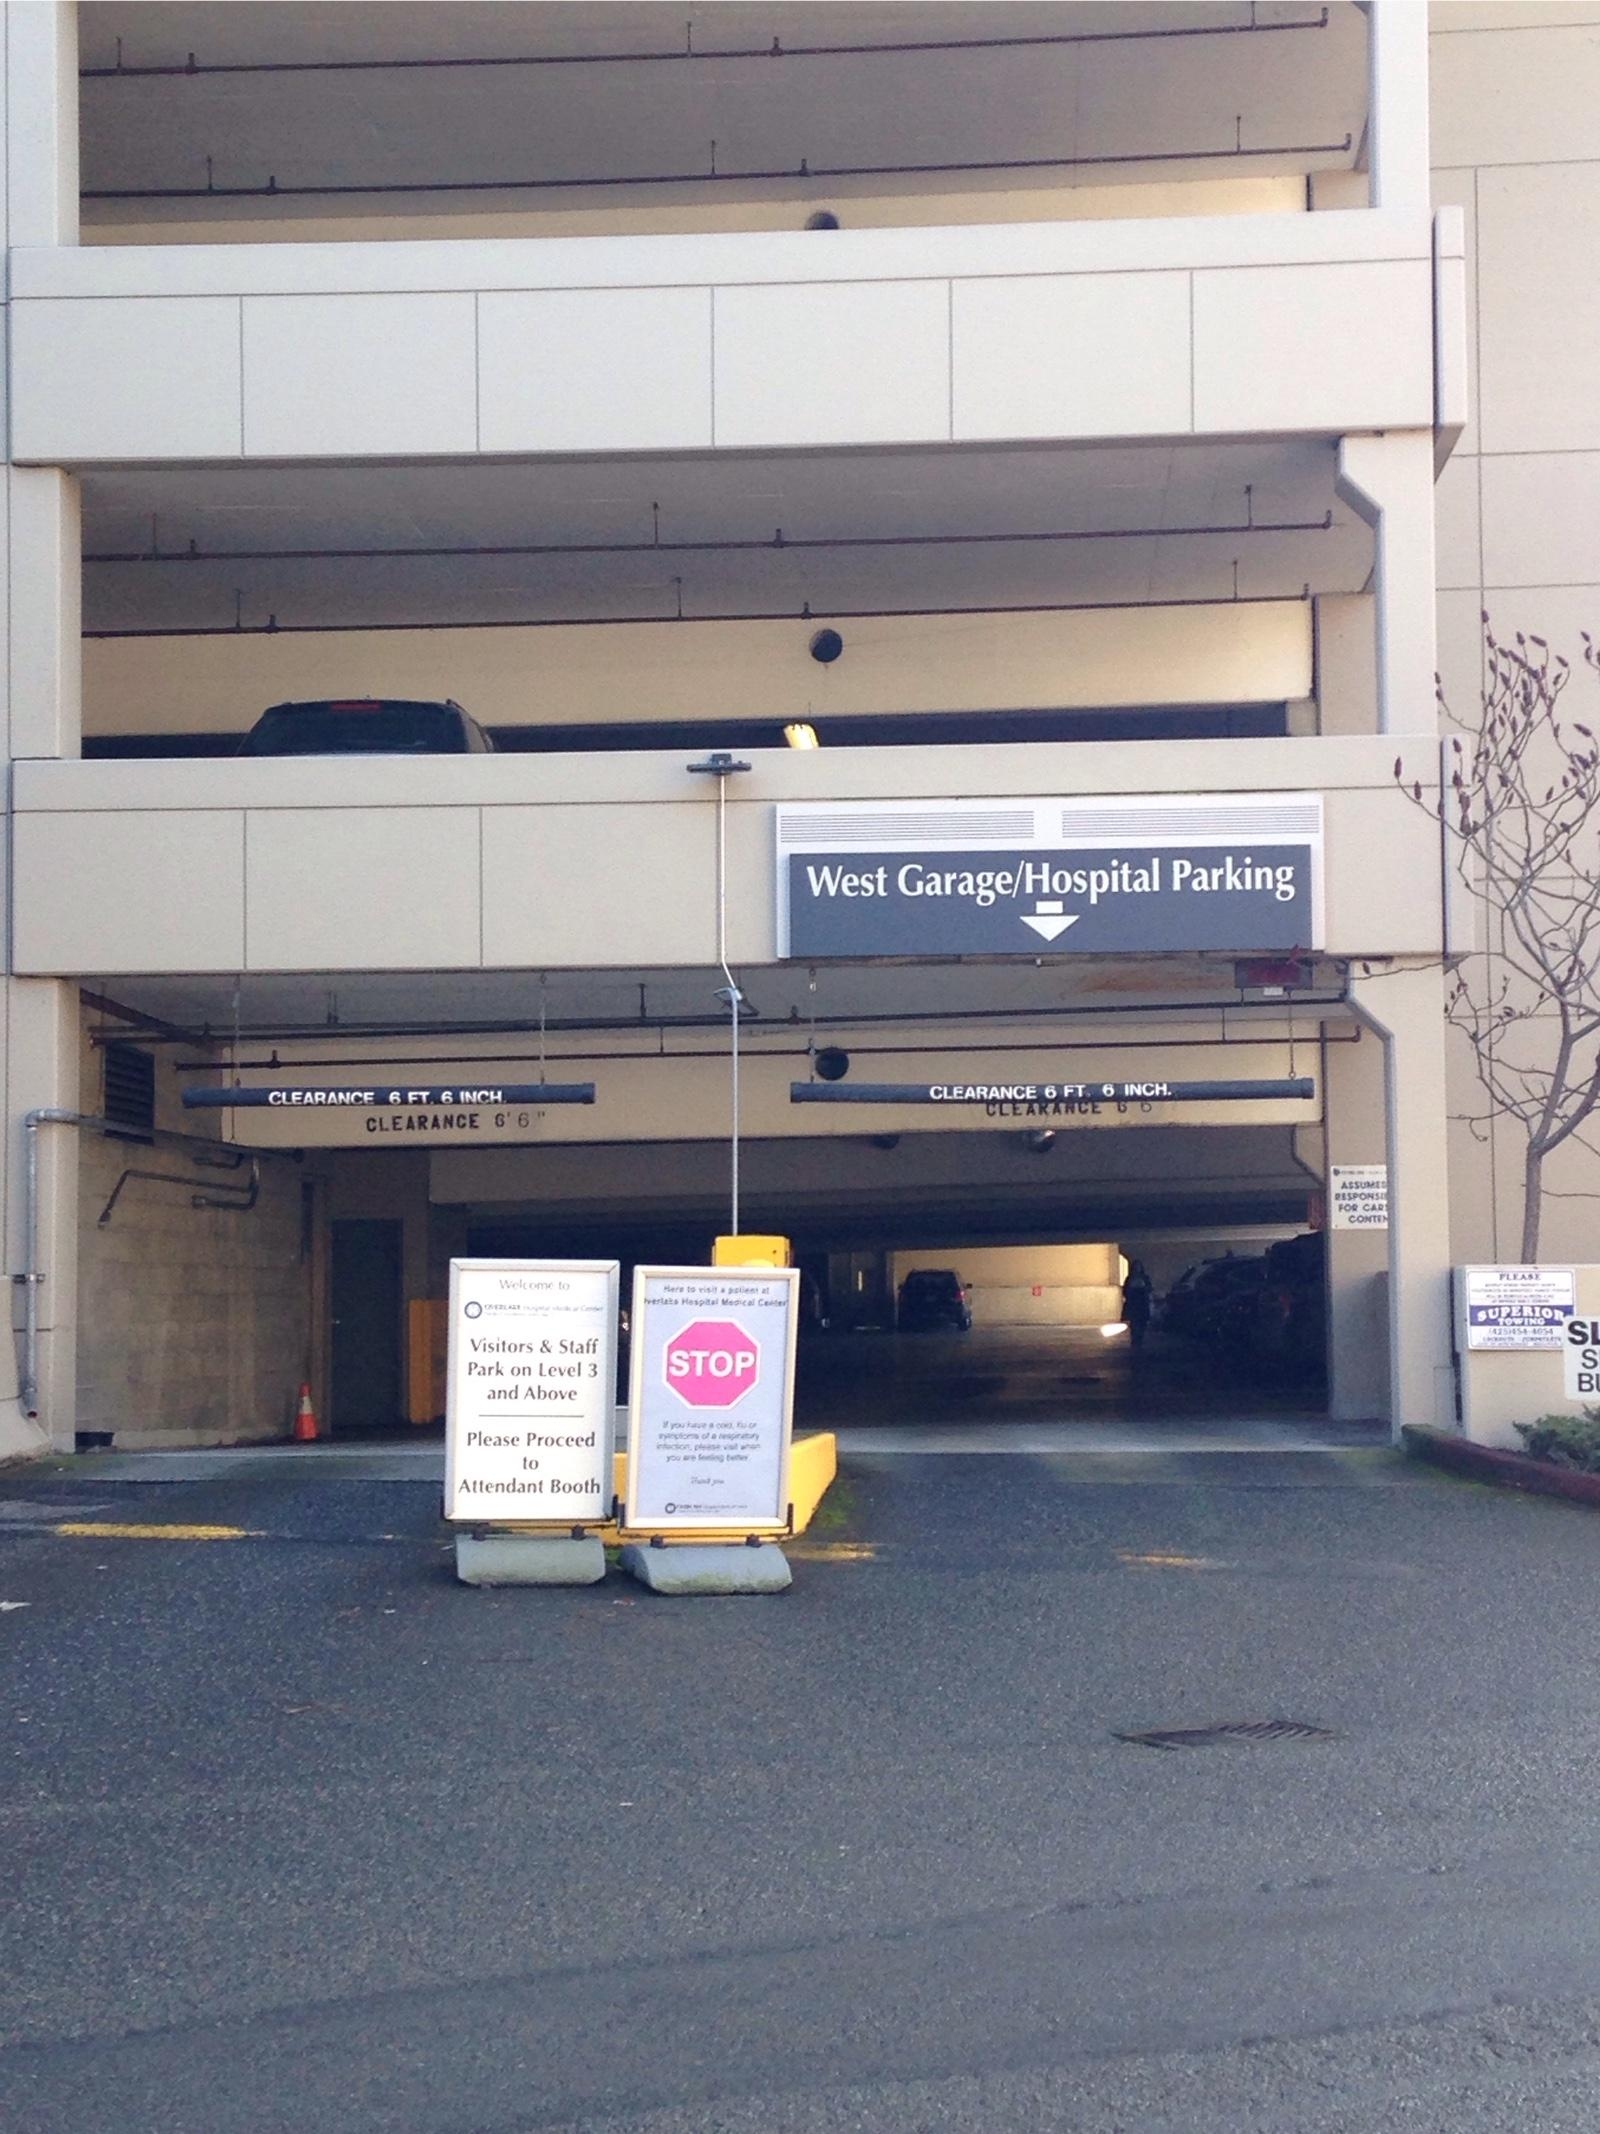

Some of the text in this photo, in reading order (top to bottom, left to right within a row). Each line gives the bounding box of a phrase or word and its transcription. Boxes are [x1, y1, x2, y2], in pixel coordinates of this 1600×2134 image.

[806, 855, 1296, 906] West Garage/Hospital Parking
[268, 1091, 375, 1107] CLEARANCE
[388, 1091, 401, 1106] 6
[407, 1091, 434, 1105] FT.
[441, 1090, 453, 1105] 6
[929, 1085, 1037, 1101] CLEARANCE
[1044, 1085, 1057, 1099] 6
[1102, 1083, 1115, 1098] 6
[1124, 1082, 1172, 1097] INCH.
[985, 1102, 1103, 1117] CLEARANCE
[366, 1113, 480, 1133] CLEARANCE
[1338, 1203, 1388, 1212] FOR CAR
[1499, 1273, 1541, 1281] PLEASE
[499, 1279, 571, 1292] Welcome to
[663, 1285, 684, 1294] Here
[687, 1286, 697, 1294] to
[699, 1285, 718, 1294] visit
[727, 1286, 759, 1296] patient
[644, 1297, 679, 1306] verlake
[681, 1298, 719, 1308] Hospital
[721, 1298, 755, 1306] Medical
[1477, 1306, 1565, 1322] SUPERIOR
[1498, 1317, 1546, 1326] TOWING
[470, 1337, 600, 1355] Visitors & Staff
[467, 1361, 599, 1379] Park on Level 3
[669, 1350, 755, 1378] STOP
[487, 1384, 578, 1402] and Above
[670, 1422, 685, 1430] you
[466, 1431, 596, 1448] Please Proceed
[522, 1456, 539, 1471] to
[666, 1454, 681, 1462] you
[458, 1478, 601, 1495] Attendant Booth
